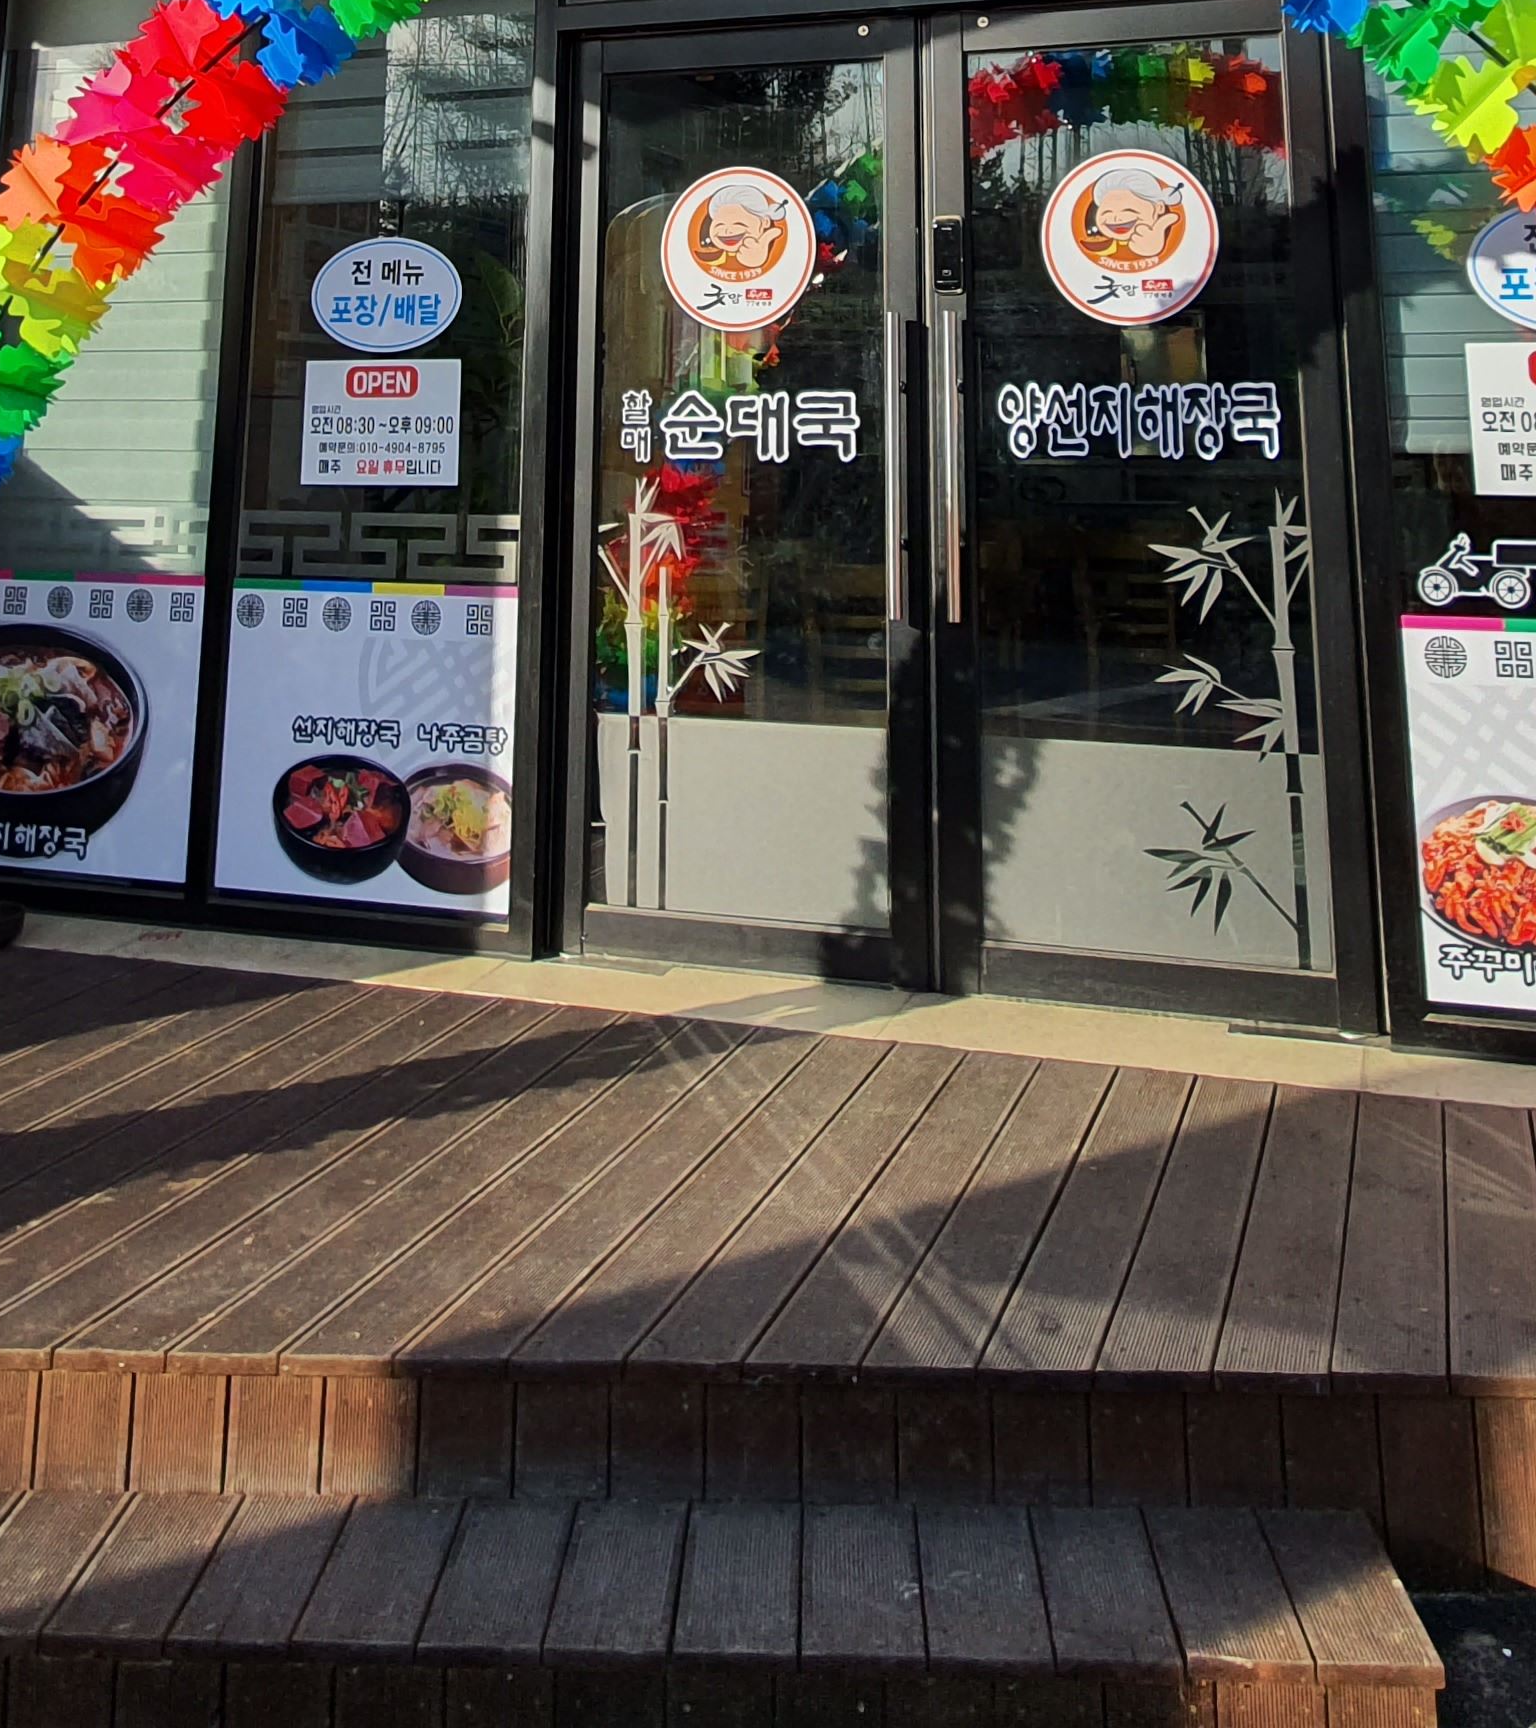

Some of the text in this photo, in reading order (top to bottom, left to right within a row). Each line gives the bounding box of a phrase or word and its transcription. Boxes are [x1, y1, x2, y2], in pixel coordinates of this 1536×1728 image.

[351, 259, 424, 286] 전 메뉴
[710, 267, 737, 281] SINCE
[1098, 256, 1159, 271] SINCE 1939
[329, 293, 441, 327] 포장/배달
[353, 371, 411, 394] OPEN
[1481, 397, 1525, 408] 영업시간
[310, 417, 333, 435] 오전
[337, 416, 374, 434] 08:30
[416, 416, 453, 435] 09:00
[660, 389, 860, 462] 순대국
[999, 382, 1281, 460] 양선지해장국
[1482, 412, 1517, 433] 오전
[319, 460, 341, 474] 매주
[356, 460, 378, 475] 요일
[1500, 465, 1533, 481] 매주
[292, 714, 508, 756] 선지해장국 나주곰탕
